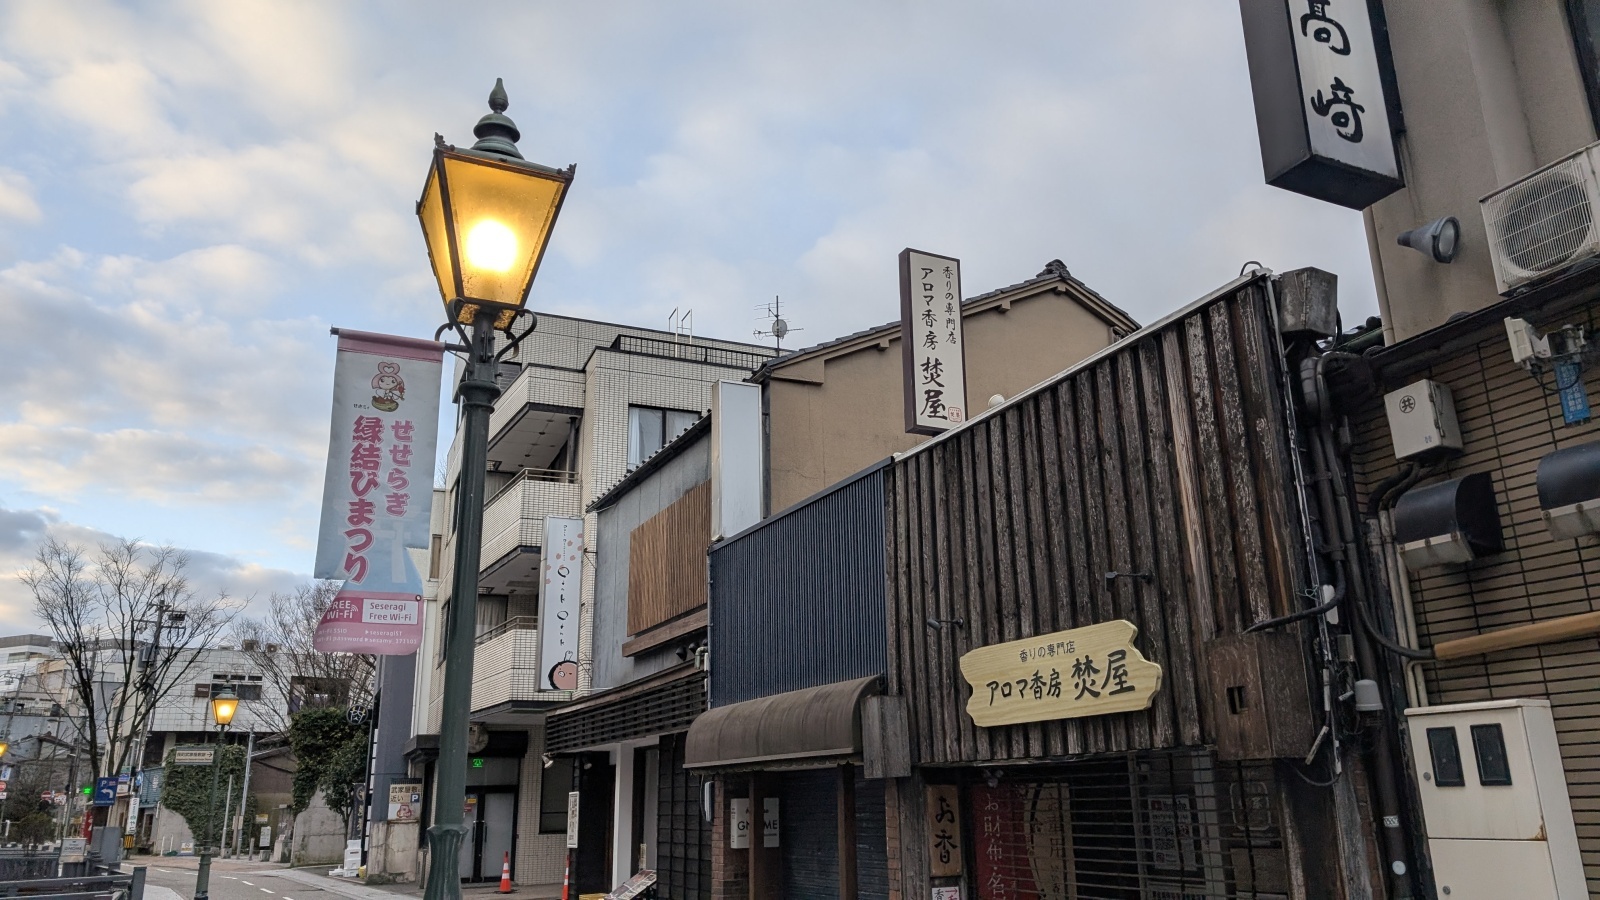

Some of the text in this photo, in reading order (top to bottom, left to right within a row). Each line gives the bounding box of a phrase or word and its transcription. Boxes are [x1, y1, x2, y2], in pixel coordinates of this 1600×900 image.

[942, 266, 957, 345] 香りの専門店
[920, 267, 948, 420] アロマ香房 焚屋
[343, 414, 385, 585] 縁結びまつり
[385, 419, 415, 518] せせらぎ
[327, 609, 353, 620] Wi-Fi
[369, 602, 407, 612] Seseragi
[369, 612, 412, 621] Free Wi-Fi
[986, 649, 1136, 706] アロマ香房 焚屋
[1019, 640, 1076, 663] 香りの専門店
[411, 794, 419, 802] P
[934, 796, 958, 864] お香
[984, 793, 1006, 900] お財布・名
